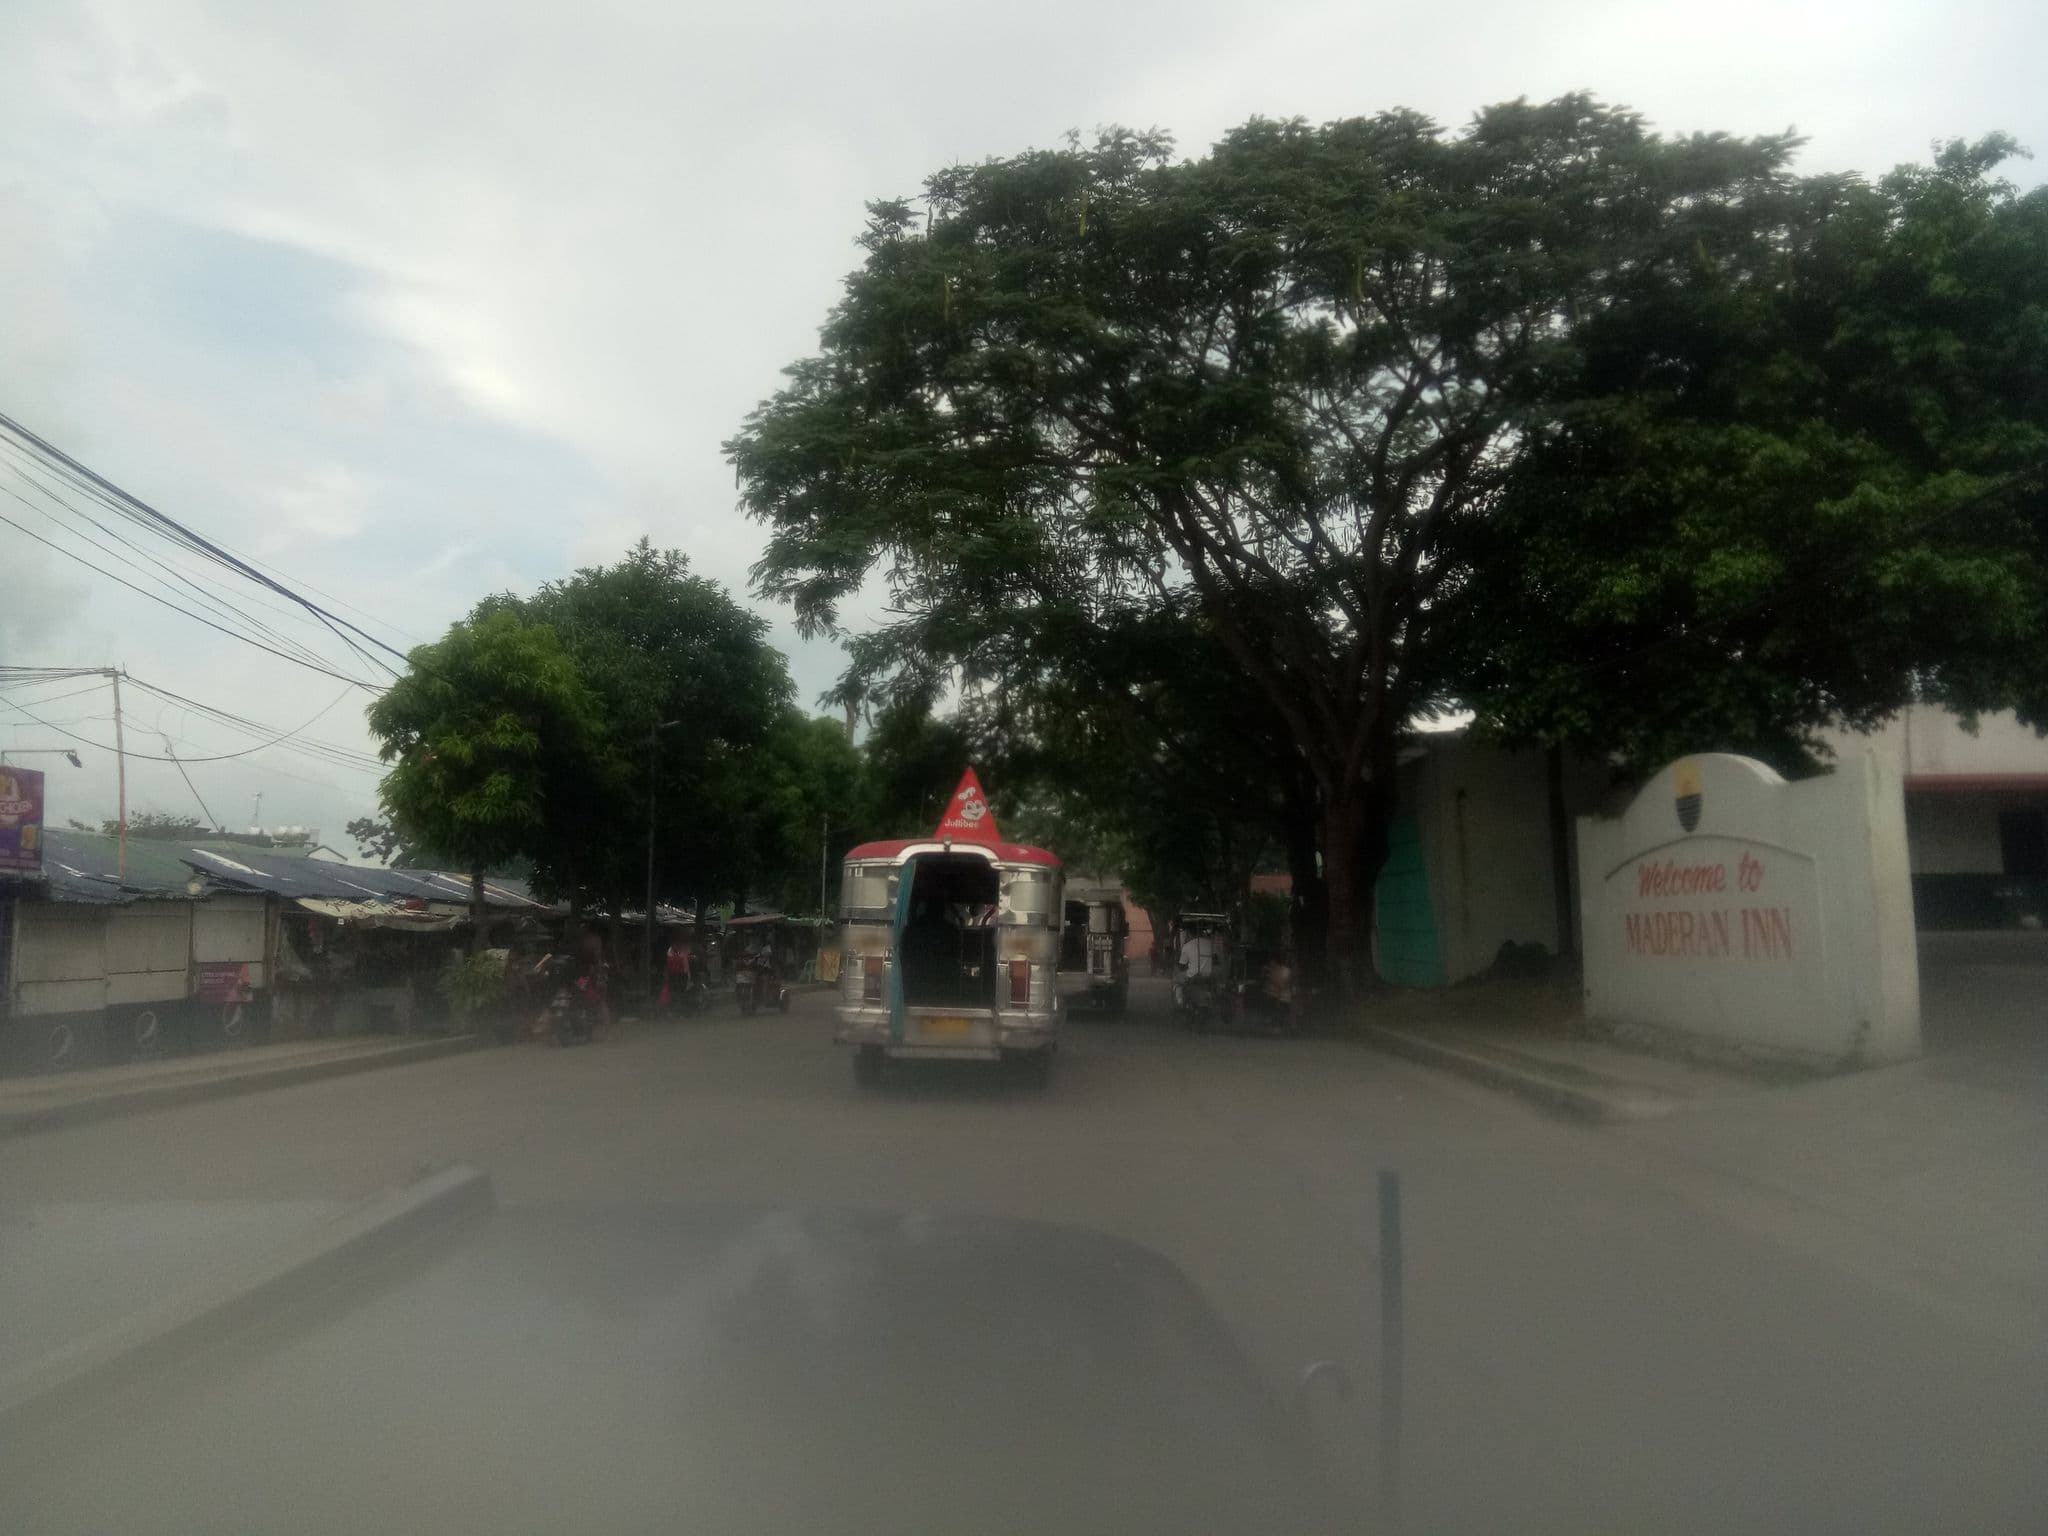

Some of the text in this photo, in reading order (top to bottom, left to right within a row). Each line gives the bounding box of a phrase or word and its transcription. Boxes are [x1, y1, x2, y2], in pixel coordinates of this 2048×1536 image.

[1638, 851, 1766, 896] Welcome to
[1741, 907, 1792, 960] INN
